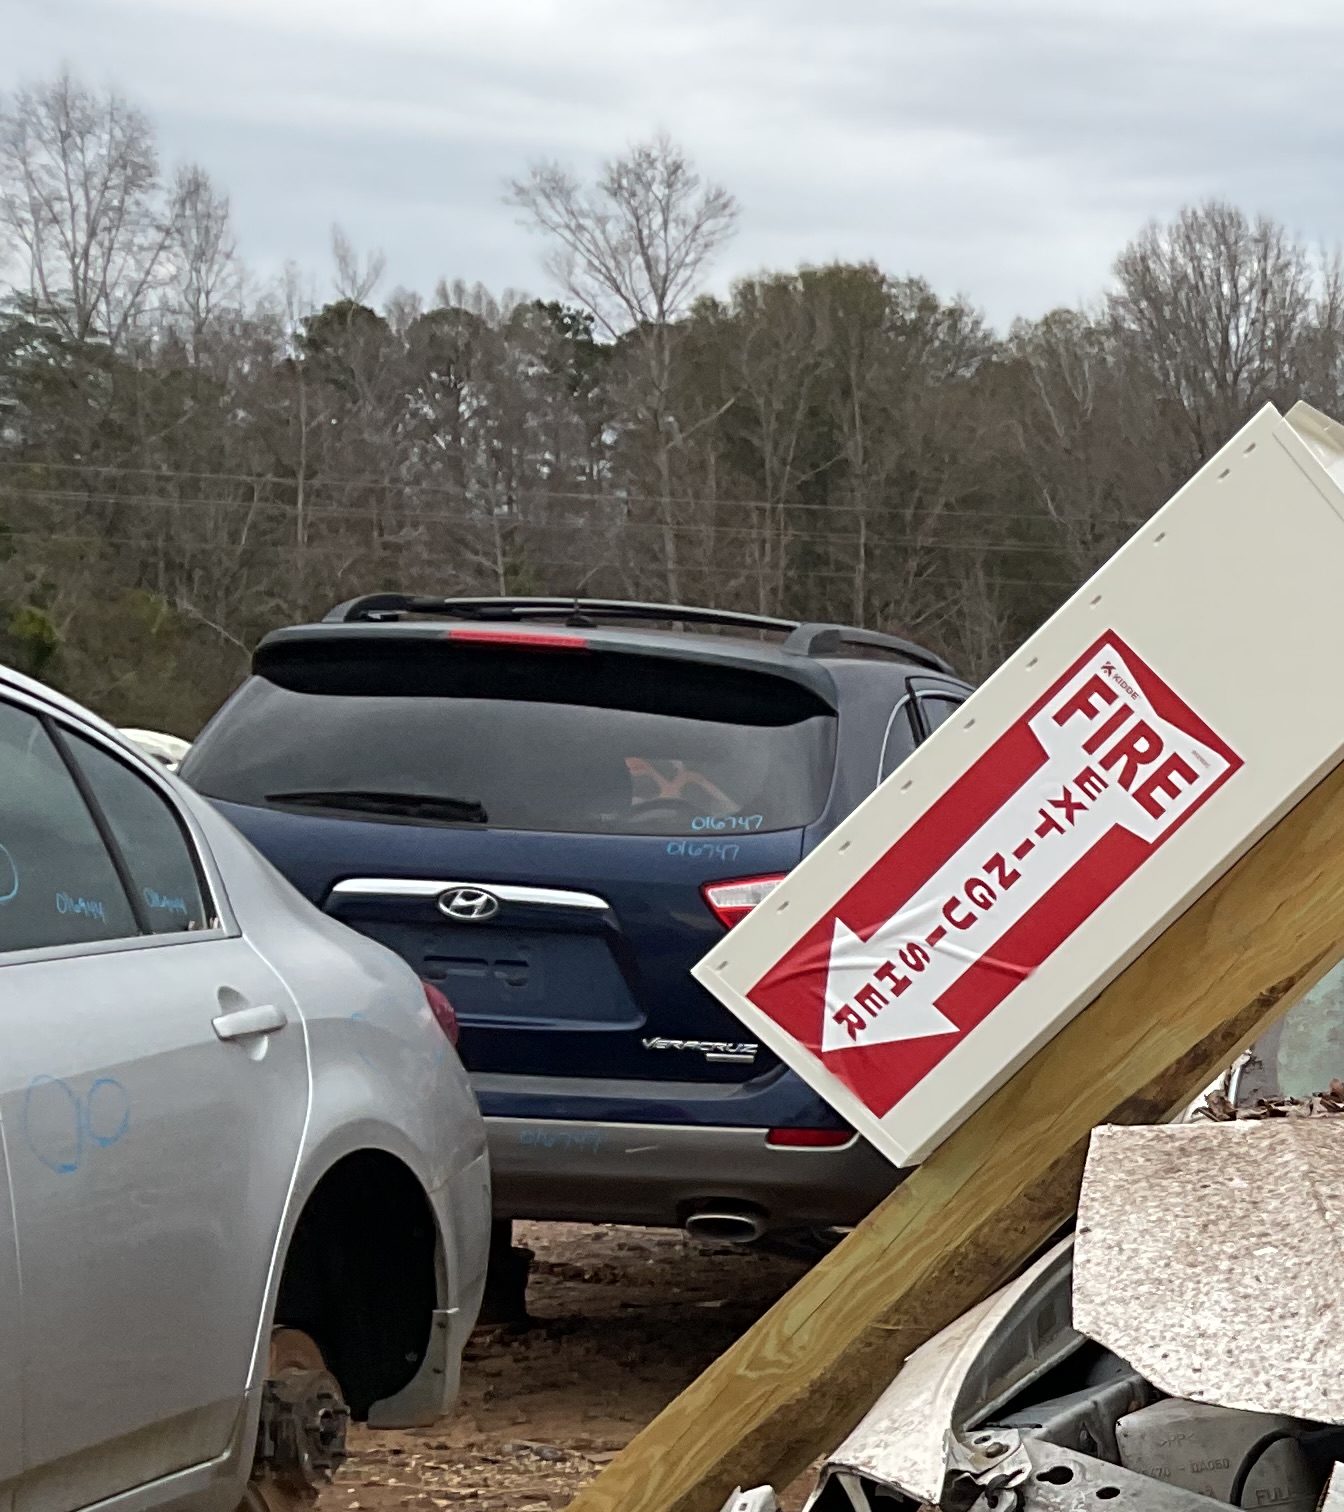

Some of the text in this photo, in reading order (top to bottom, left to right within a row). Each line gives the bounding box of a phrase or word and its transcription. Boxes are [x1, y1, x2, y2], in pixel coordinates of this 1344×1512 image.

[1112, 673, 1140, 700] KIDDE
[1052, 674, 1200, 820] FIRE
[691, 814, 764, 831] 016747
[666, 840, 740, 861] 016747
[832, 766, 1109, 1041] EXTINGUISHER
[642, 1036, 759, 1053] VERACRUZ
